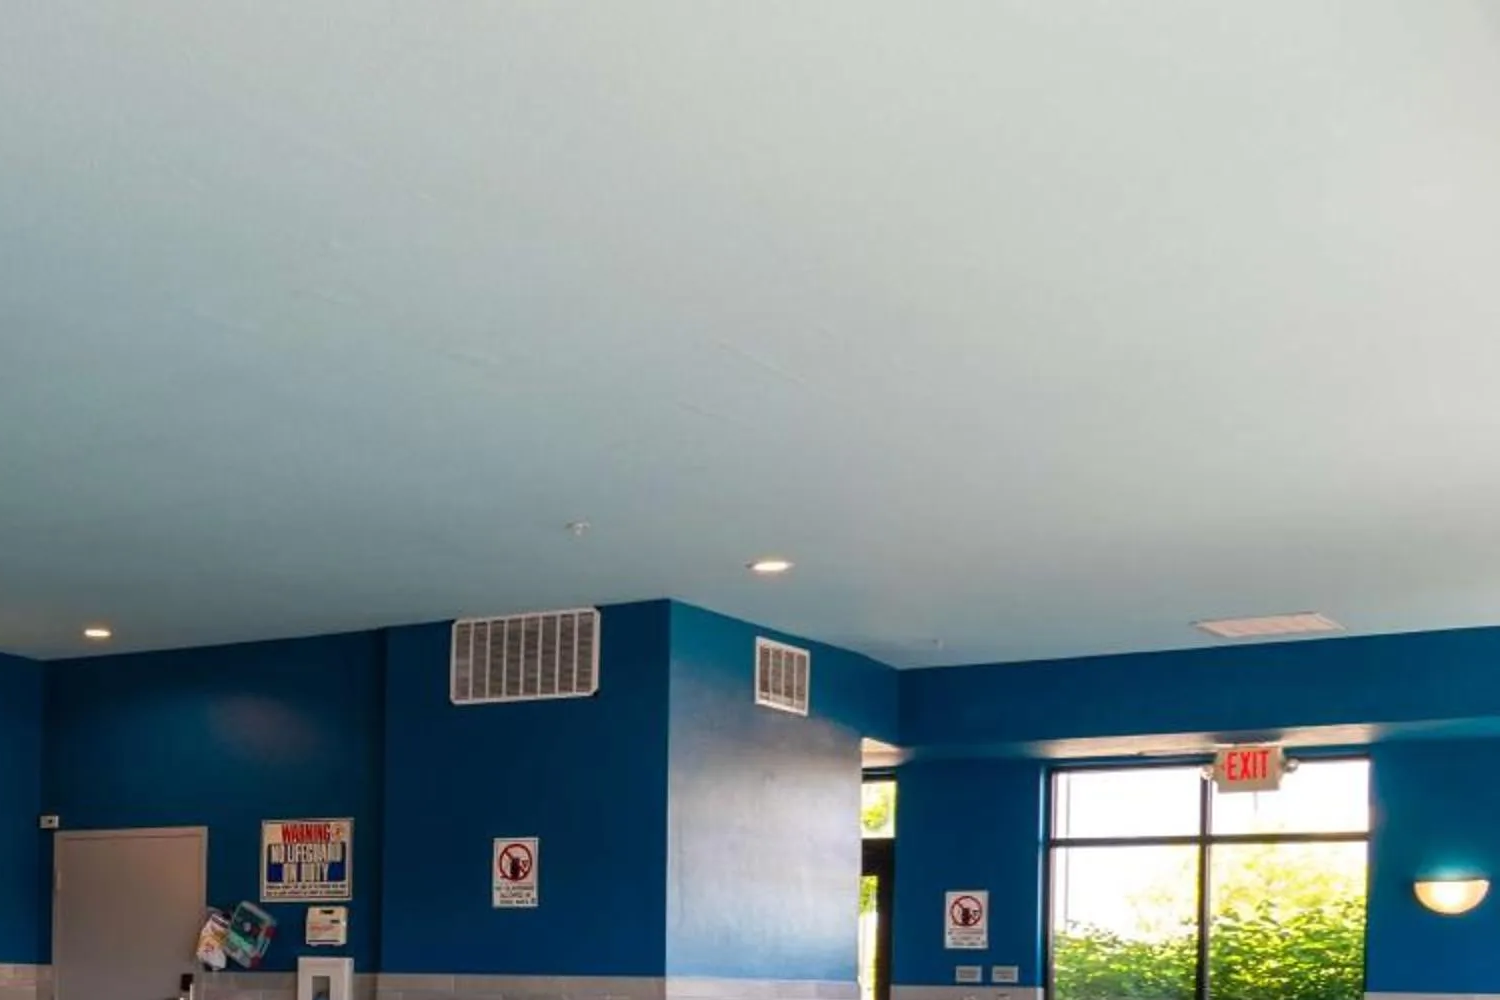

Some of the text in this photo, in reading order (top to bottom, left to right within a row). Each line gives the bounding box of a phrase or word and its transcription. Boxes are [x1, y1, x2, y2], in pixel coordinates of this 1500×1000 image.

[1227, 750, 1268, 781] EXIT
[281, 823, 331, 842] WARNING
[271, 843, 285, 863] NO
